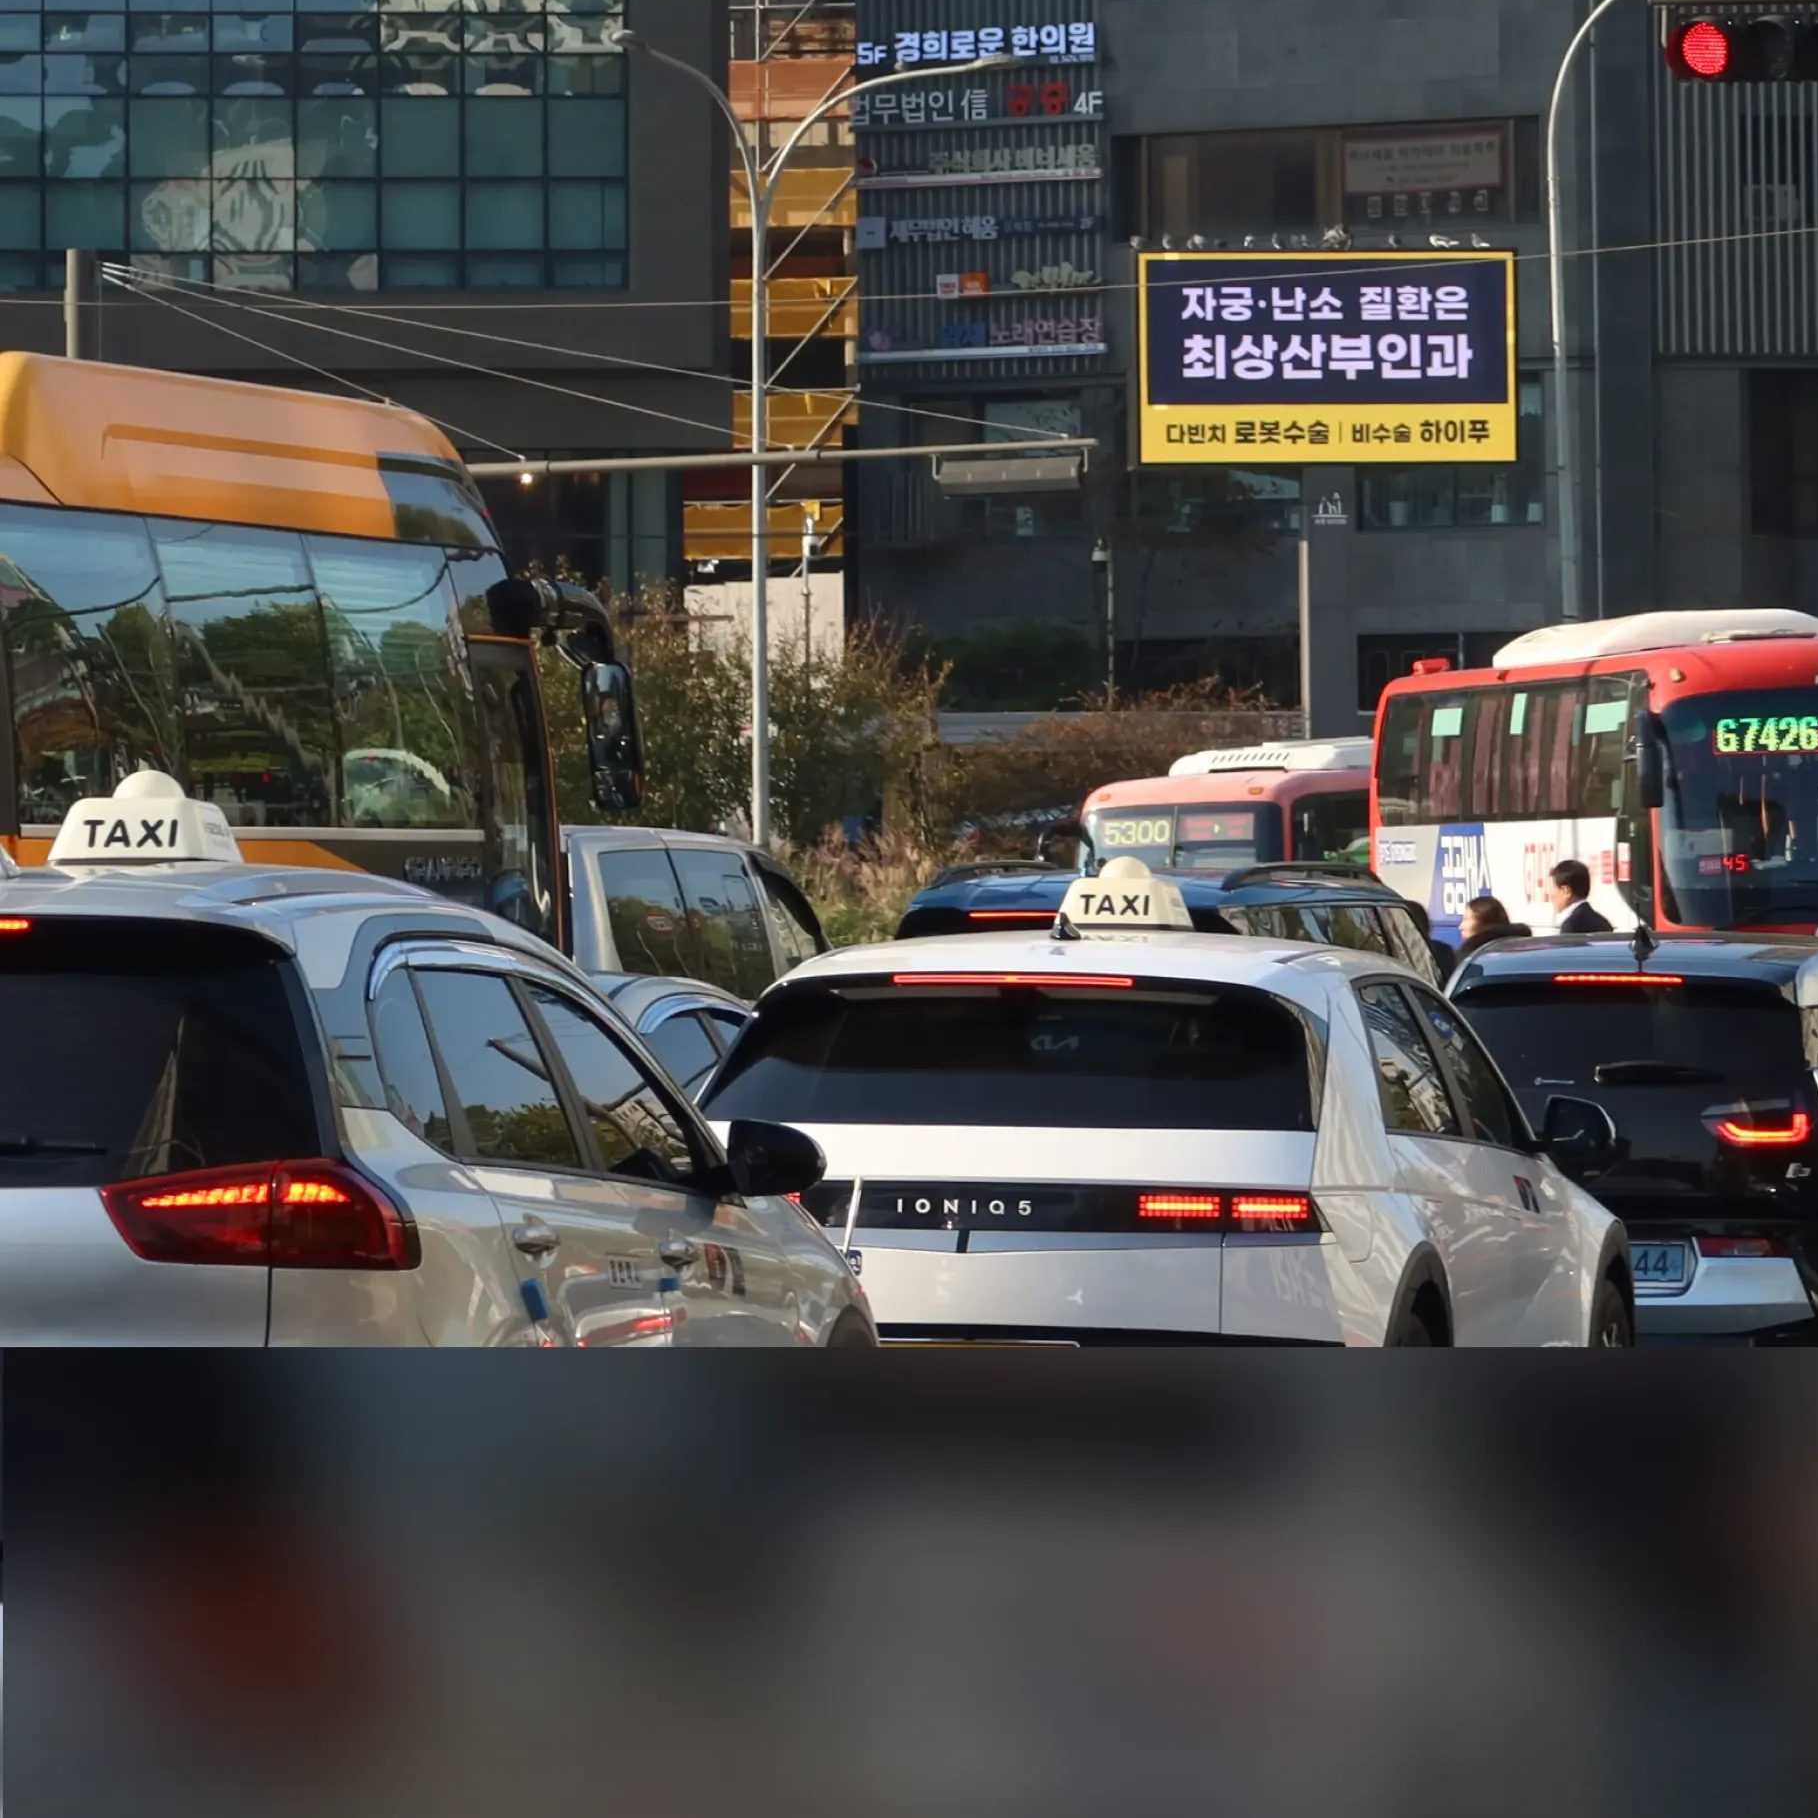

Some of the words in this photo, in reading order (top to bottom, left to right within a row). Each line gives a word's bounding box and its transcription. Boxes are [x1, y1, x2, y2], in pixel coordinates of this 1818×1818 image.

[857, 42, 887, 65] 5F
[894, 27, 1004, 62] 경희로운
[1011, 22, 1095, 56] 한의원
[1073, 91, 1104, 115] 4F
[1359, 285, 1470, 321] 질환은
[1181, 333, 1474, 381] 최상산부인과
[1166, 424, 1227, 445] 다빈치
[1234, 422, 1330, 445] 로봇수술
[1351, 423, 1412, 444] 비수술
[1419, 419, 1491, 444] 하이푸
[83, 819, 179, 848] TAXI
[1104, 820, 1170, 845] 5300
[1723, 854, 1748, 871] 45
[1080, 894, 1150, 916] TAXI
